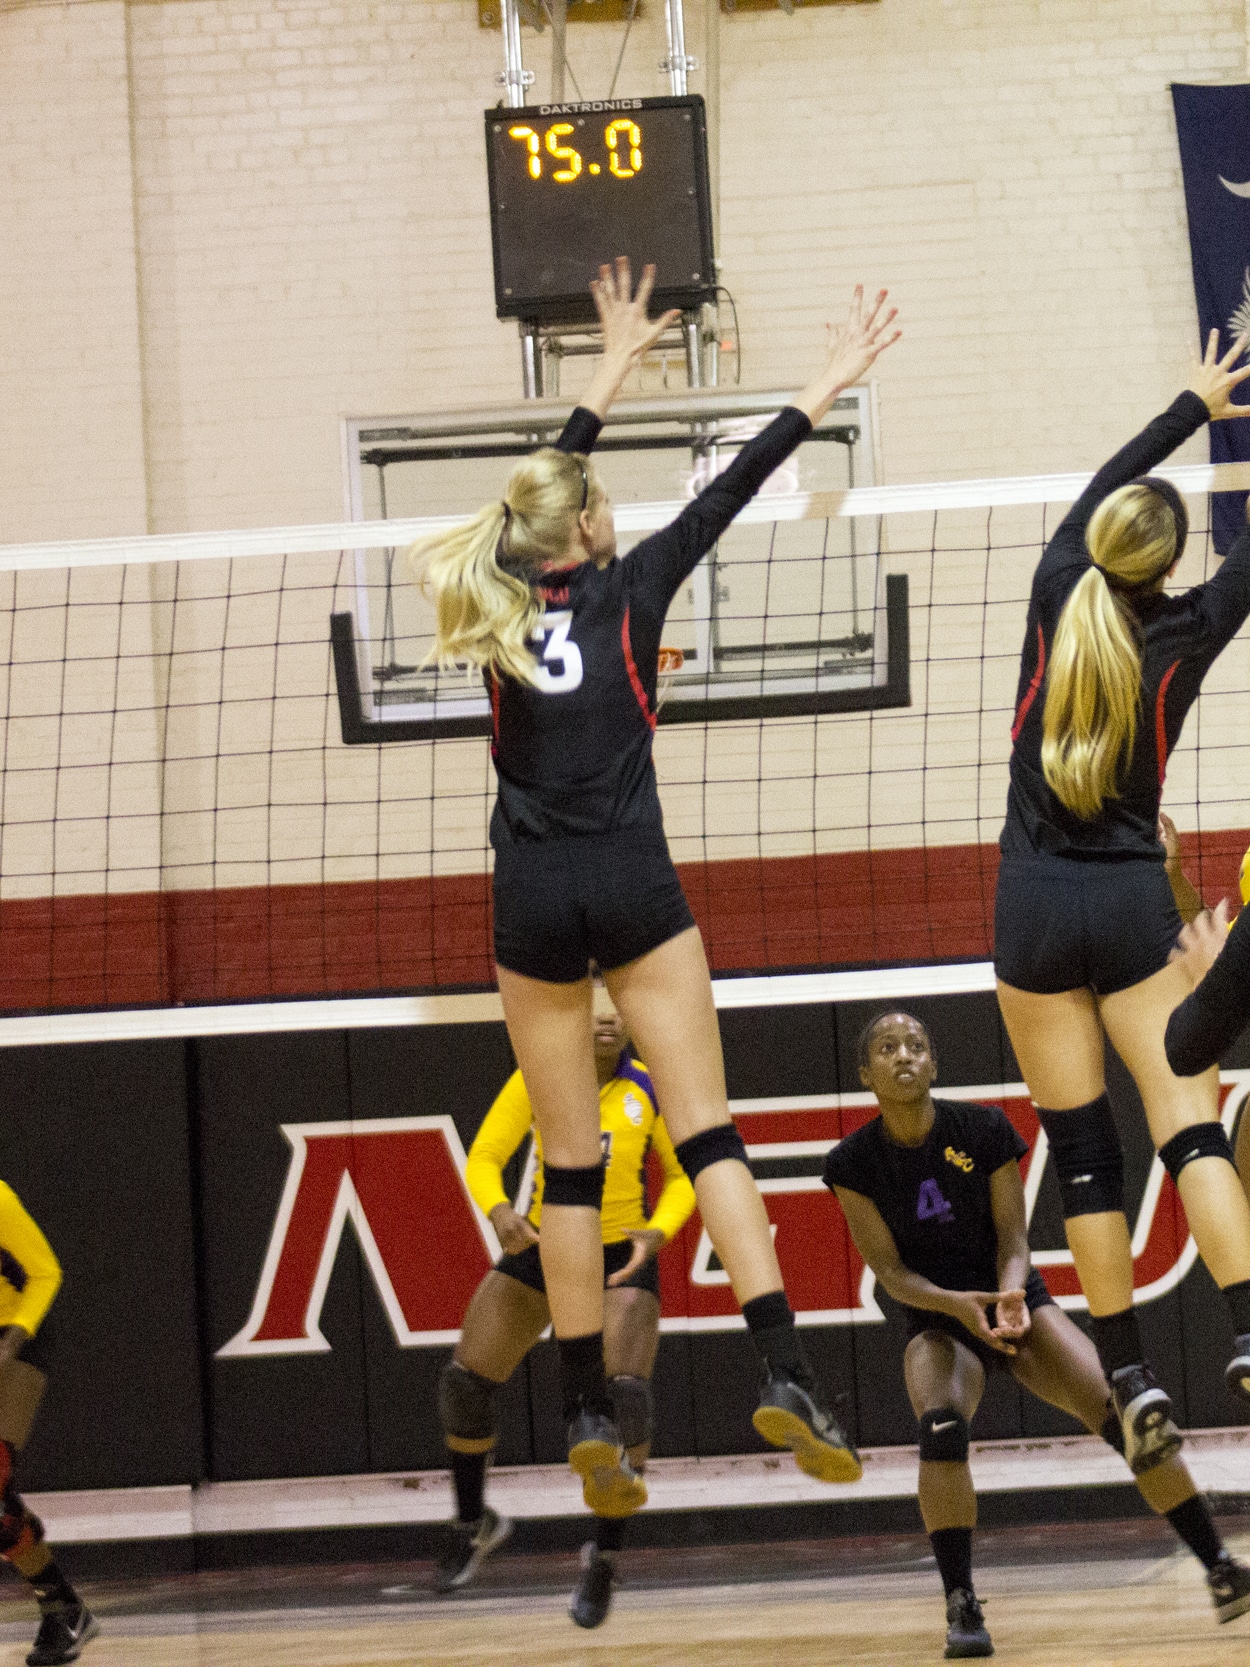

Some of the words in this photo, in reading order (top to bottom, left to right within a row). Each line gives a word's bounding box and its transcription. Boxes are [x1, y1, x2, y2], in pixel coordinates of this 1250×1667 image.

[540, 99, 643, 116] DAKTRONICS
[508, 118, 642, 182] 75.0
[532, 610, 584, 694] 3
[916, 1177, 955, 1223] 4
